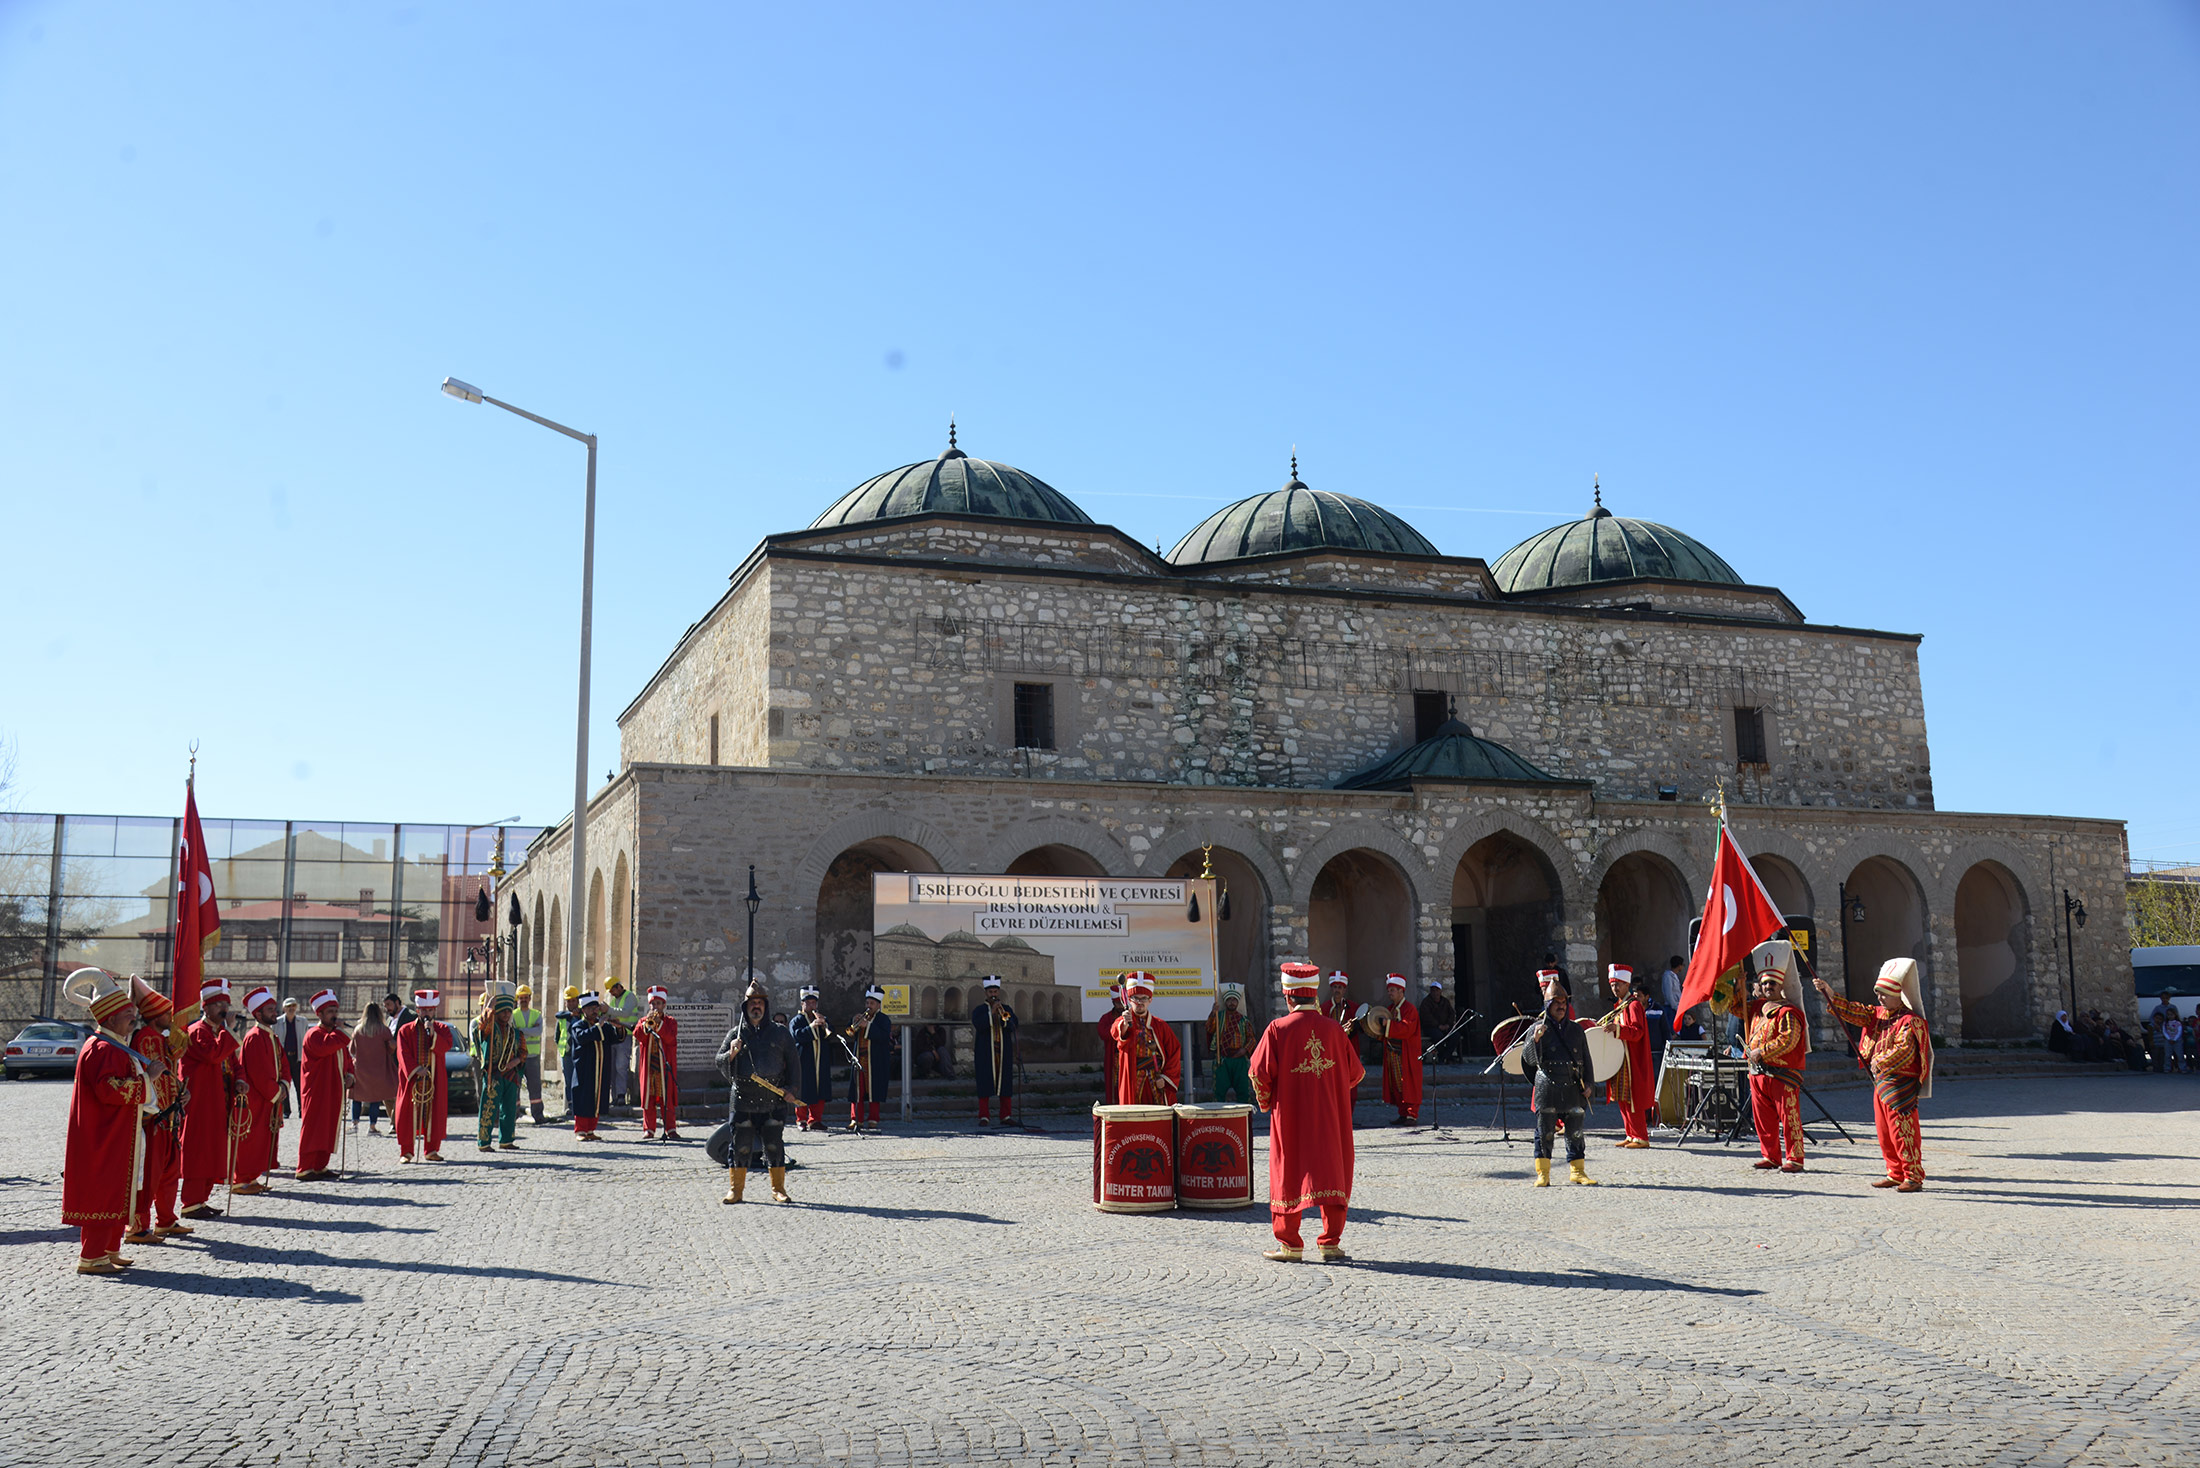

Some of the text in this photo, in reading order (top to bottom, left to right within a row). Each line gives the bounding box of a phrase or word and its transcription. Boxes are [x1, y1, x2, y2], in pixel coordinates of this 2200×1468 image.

[917, 882, 1181, 902] EŞREFOĞLU BEDESTENİ VE ÇEVRESİ
[990, 902, 1111, 915] RESTORASYONU &
[980, 916, 1122, 931] ÇEVRE DÜZENLEMESİ
[1107, 1143, 1122, 1166] KONYA
[1180, 1174, 1247, 1189] MEHTER TAKIMI
[1105, 1182, 1144, 1197] MEHTER
